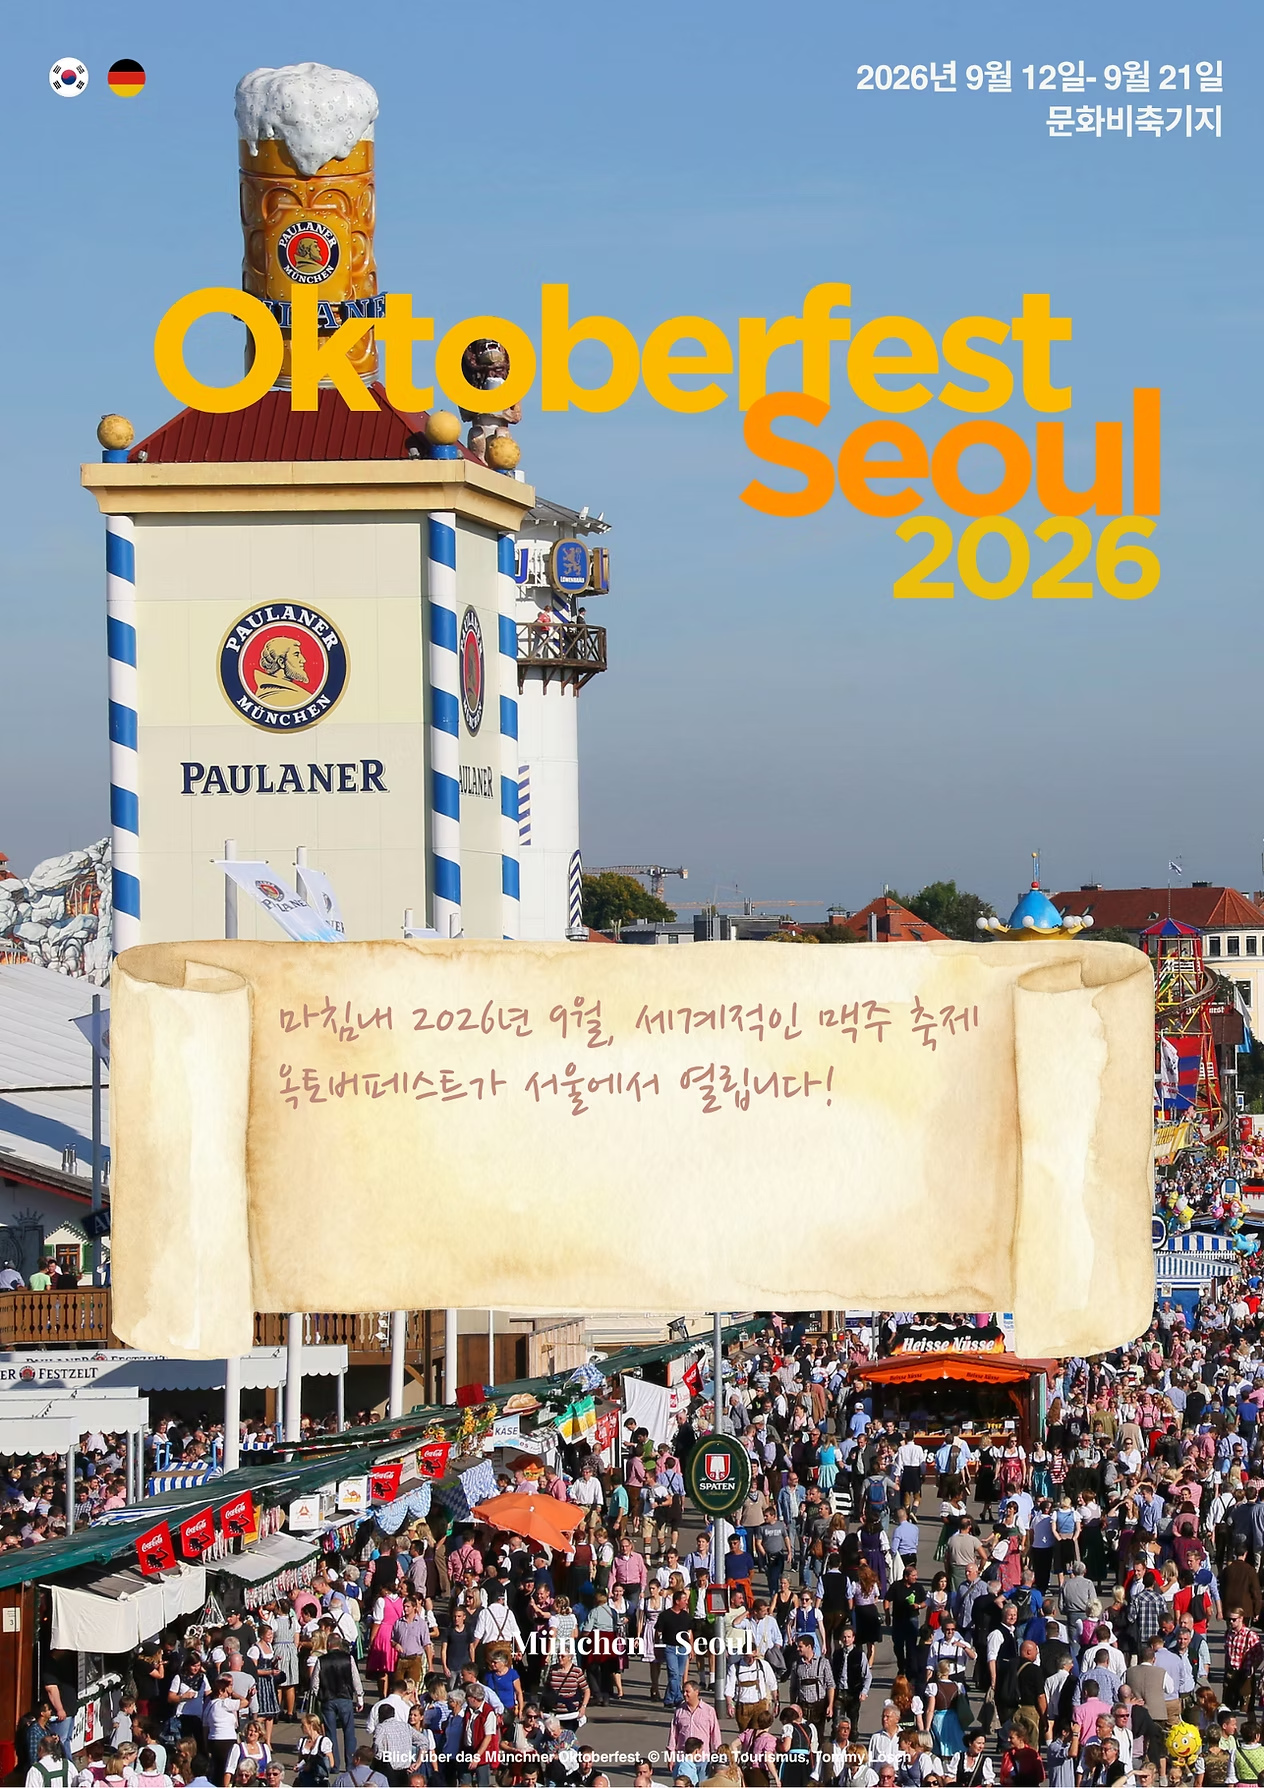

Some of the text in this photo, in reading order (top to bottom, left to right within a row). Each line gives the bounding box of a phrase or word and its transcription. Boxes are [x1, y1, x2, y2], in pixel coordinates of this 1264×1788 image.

[279, 222, 337, 248] PAULANER
[284, 265, 334, 284] MÜNCHEN
[226, 605, 338, 652] PAULANER
[237, 694, 331, 725] MÜNCHEN
[180, 759, 388, 794] PAULANER
[459, 765, 494, 798] AULANER
[902, 1335, 995, 1352] Heisse Nüsse
[39, 1368, 98, 1379] FESTZELT
[494, 1424, 519, 1436] KÄSE
[699, 1482, 736, 1490] SPATEN
